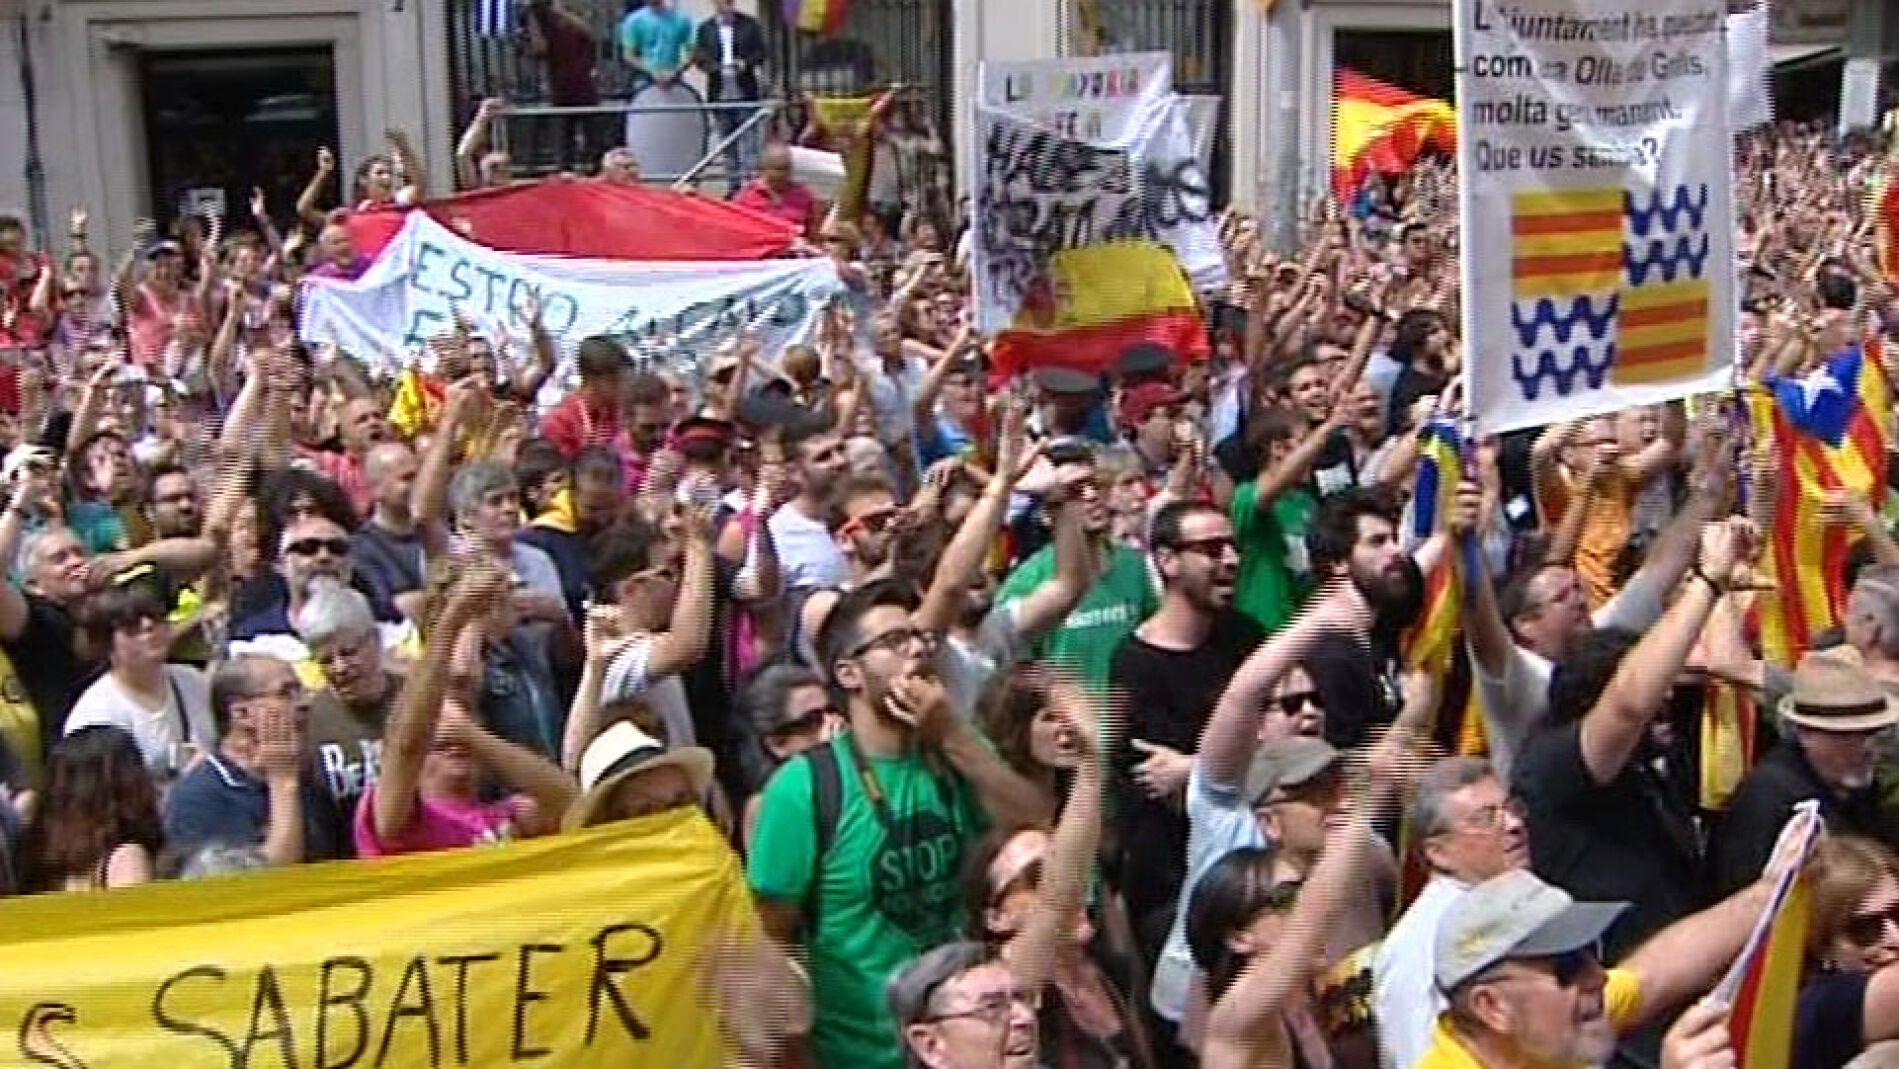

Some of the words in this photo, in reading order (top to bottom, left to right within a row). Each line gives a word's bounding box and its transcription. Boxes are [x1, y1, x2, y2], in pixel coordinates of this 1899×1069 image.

[1473, 55, 1532, 77] com
[1473, 94, 1547, 124] molta
[1477, 138, 1521, 170] Que
[1529, 147, 1564, 168] us
[880, 833, 959, 892] STOP
[152, 921, 663, 1069] SABATER
